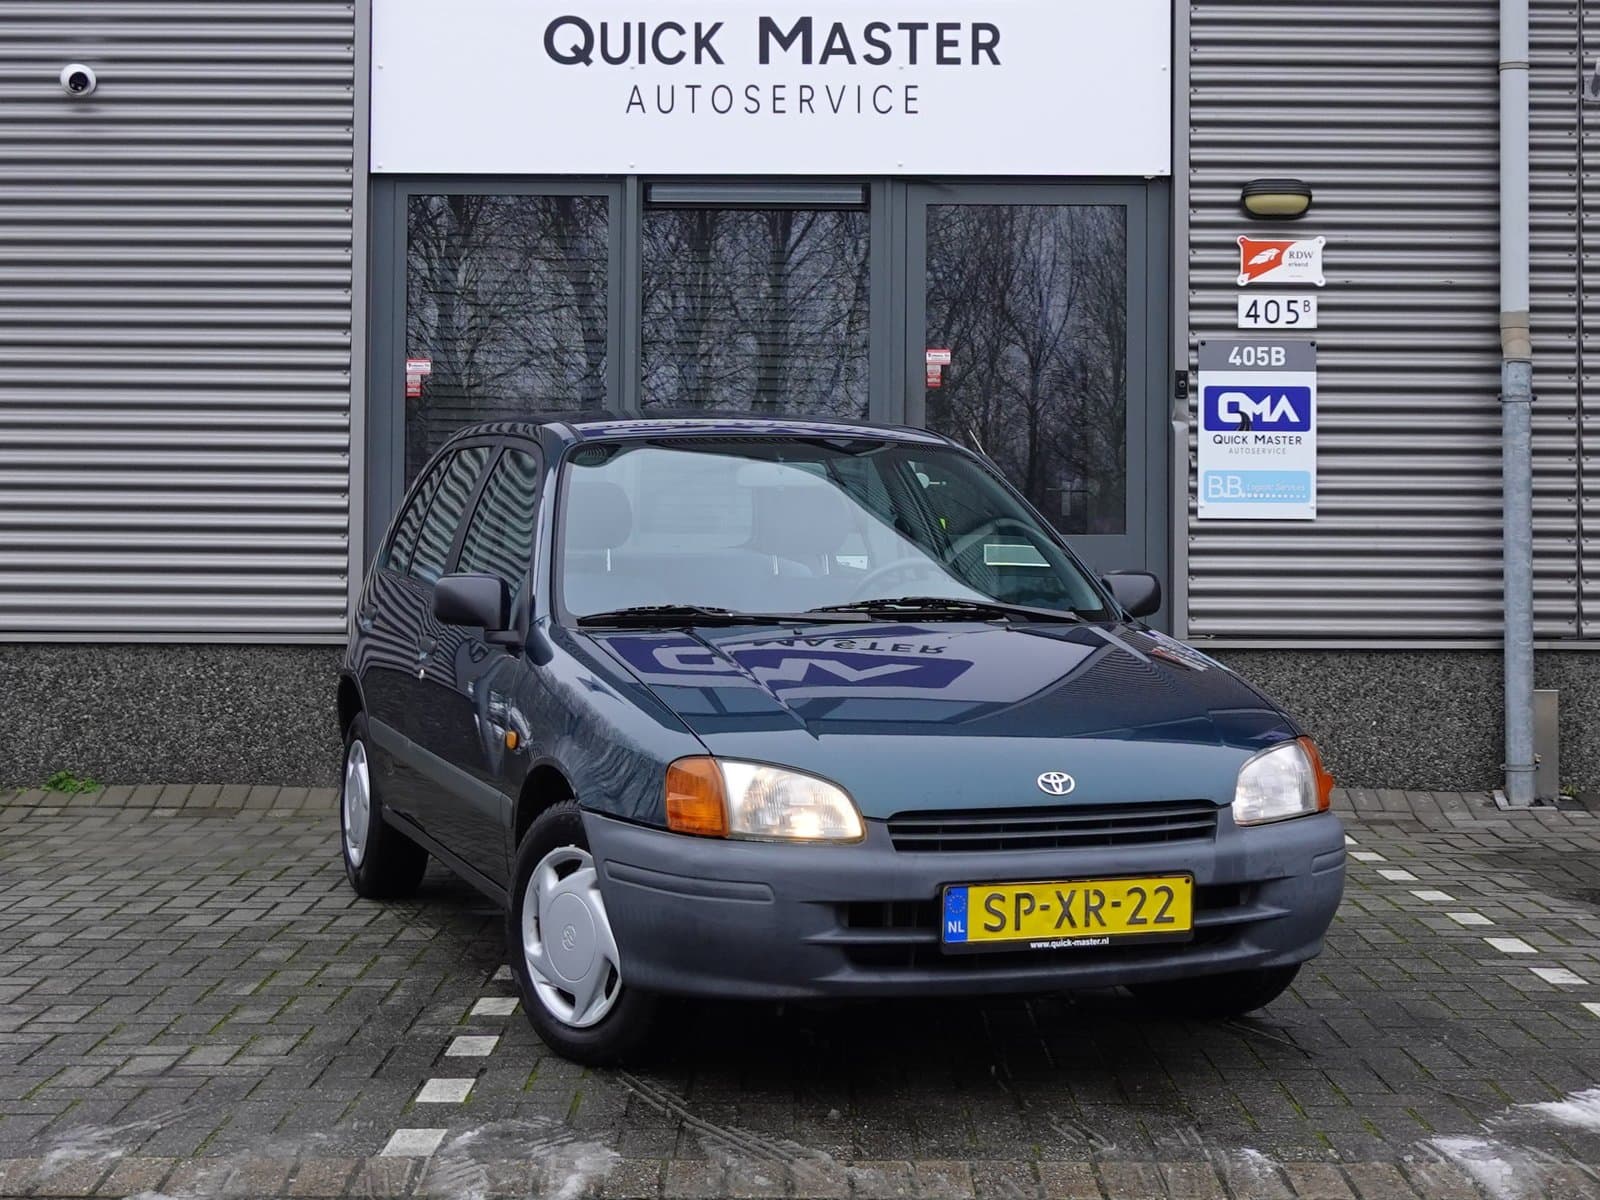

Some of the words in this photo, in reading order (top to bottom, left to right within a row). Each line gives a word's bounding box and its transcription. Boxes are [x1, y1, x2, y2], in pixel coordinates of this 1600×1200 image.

[543, 15, 725, 67] QUICK
[758, 15, 1002, 66] MASTER
[626, 84, 920, 114] AUTOSERVICE
[1288, 250, 1313, 259] RDW
[1228, 346, 1286, 366] 405B
[1228, 447, 1287, 455] AUTOSERVICE
[983, 885, 1175, 932] SP-XR-22
[947, 920, 965, 934] NL
[1030, 936, 1110, 950] www.quick-master.nl
